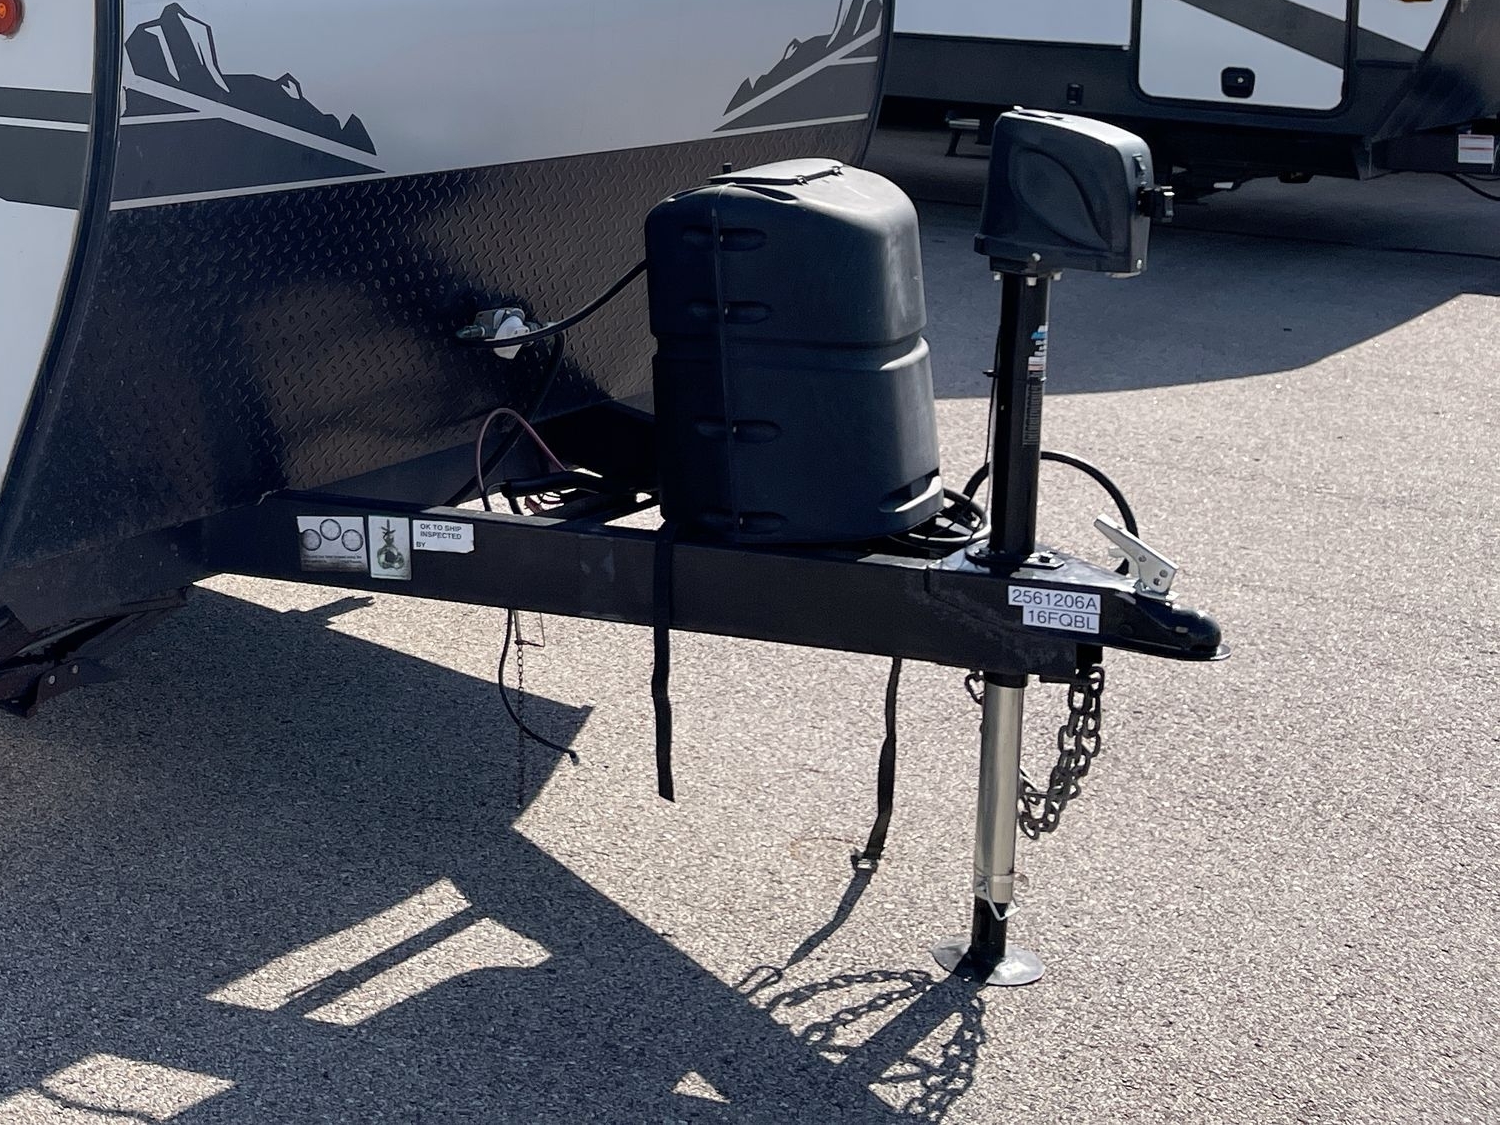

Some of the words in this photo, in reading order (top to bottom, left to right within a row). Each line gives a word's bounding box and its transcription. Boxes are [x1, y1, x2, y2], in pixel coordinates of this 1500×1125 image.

[420, 523, 432, 531] OK
[420, 531, 462, 540] INSPECTED
[1011, 589, 1098, 610] 2561206A
[1028, 610, 1096, 630] 16FQBL
